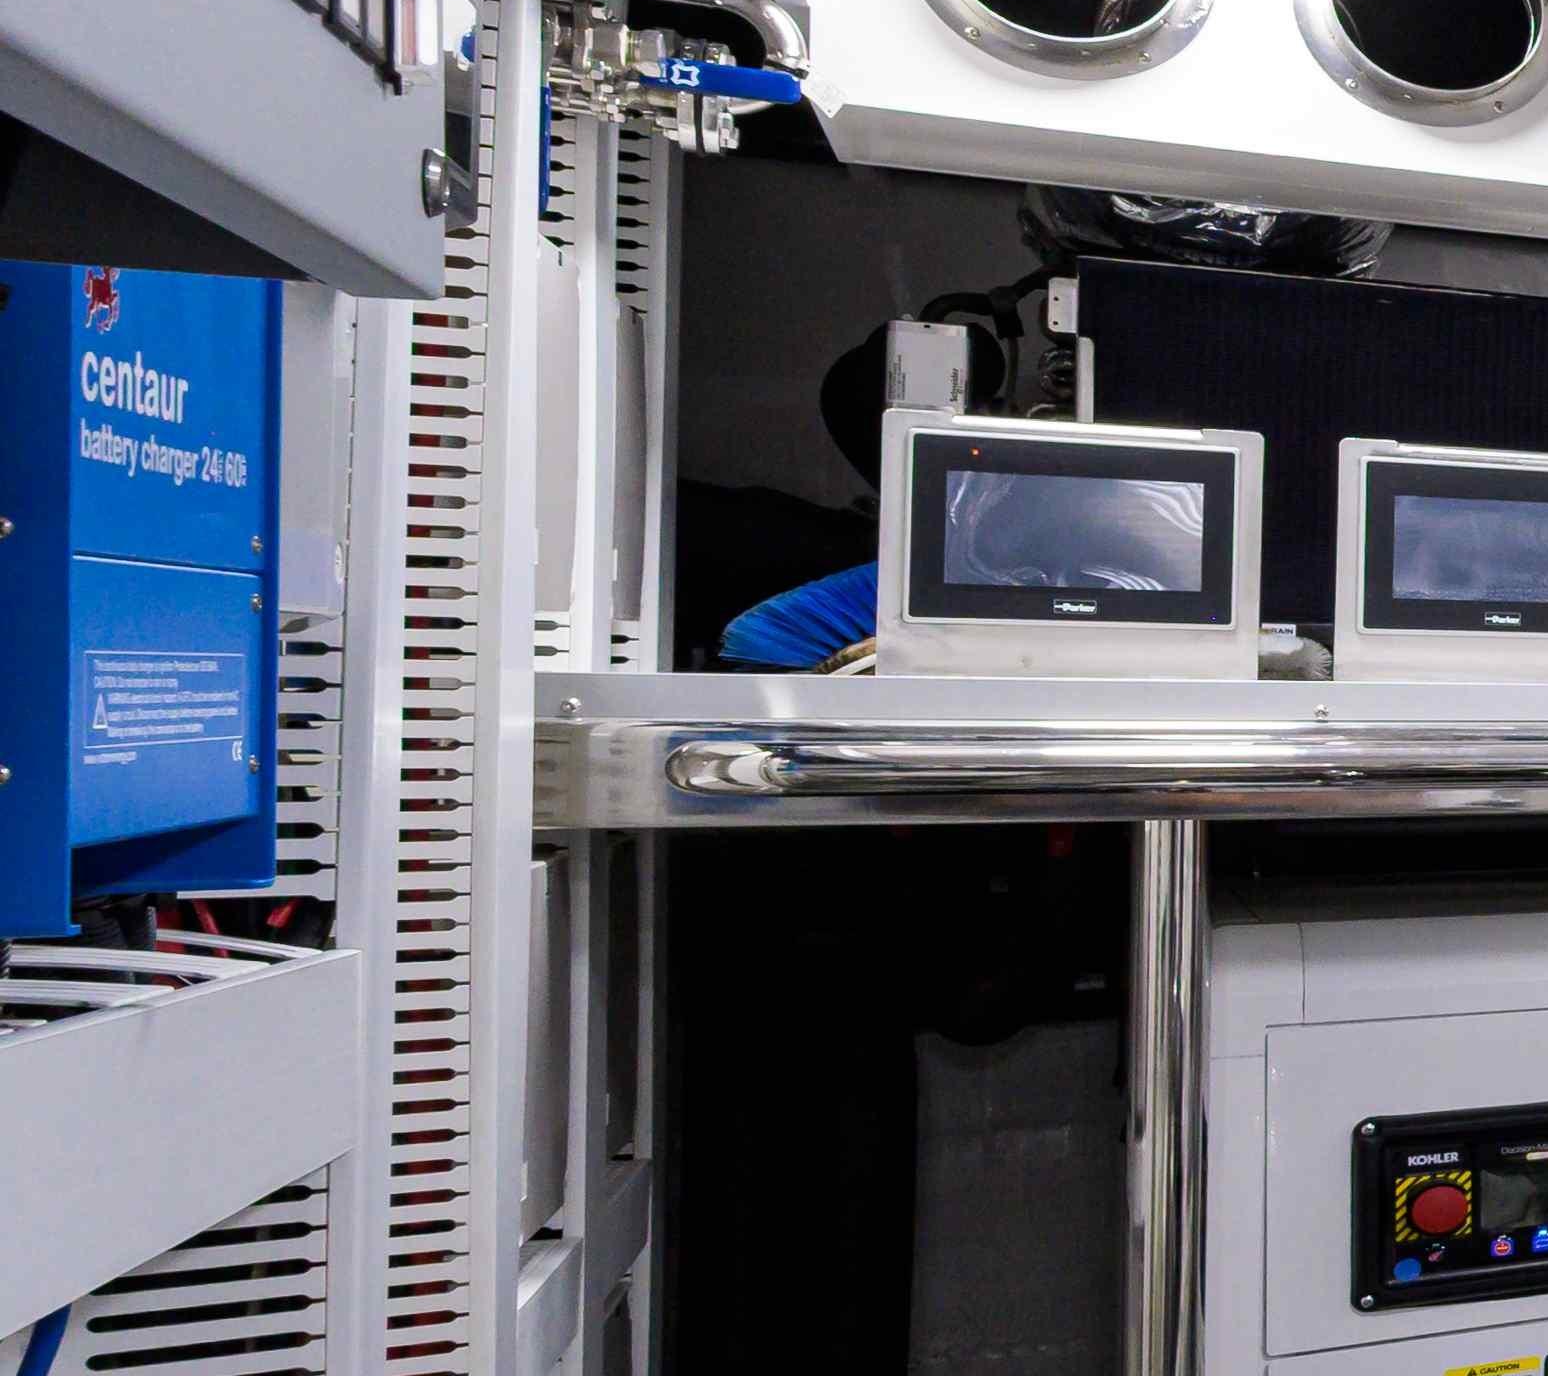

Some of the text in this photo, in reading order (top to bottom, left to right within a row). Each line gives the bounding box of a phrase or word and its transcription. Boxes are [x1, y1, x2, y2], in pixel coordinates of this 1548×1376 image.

[81, 351, 189, 424] centaur
[80, 417, 139, 477] battery
[141, 434, 199, 487] charger
[1407, 1151, 1460, 1167] KOHLER
[1479, 1362, 1520, 1375] CAUTION
